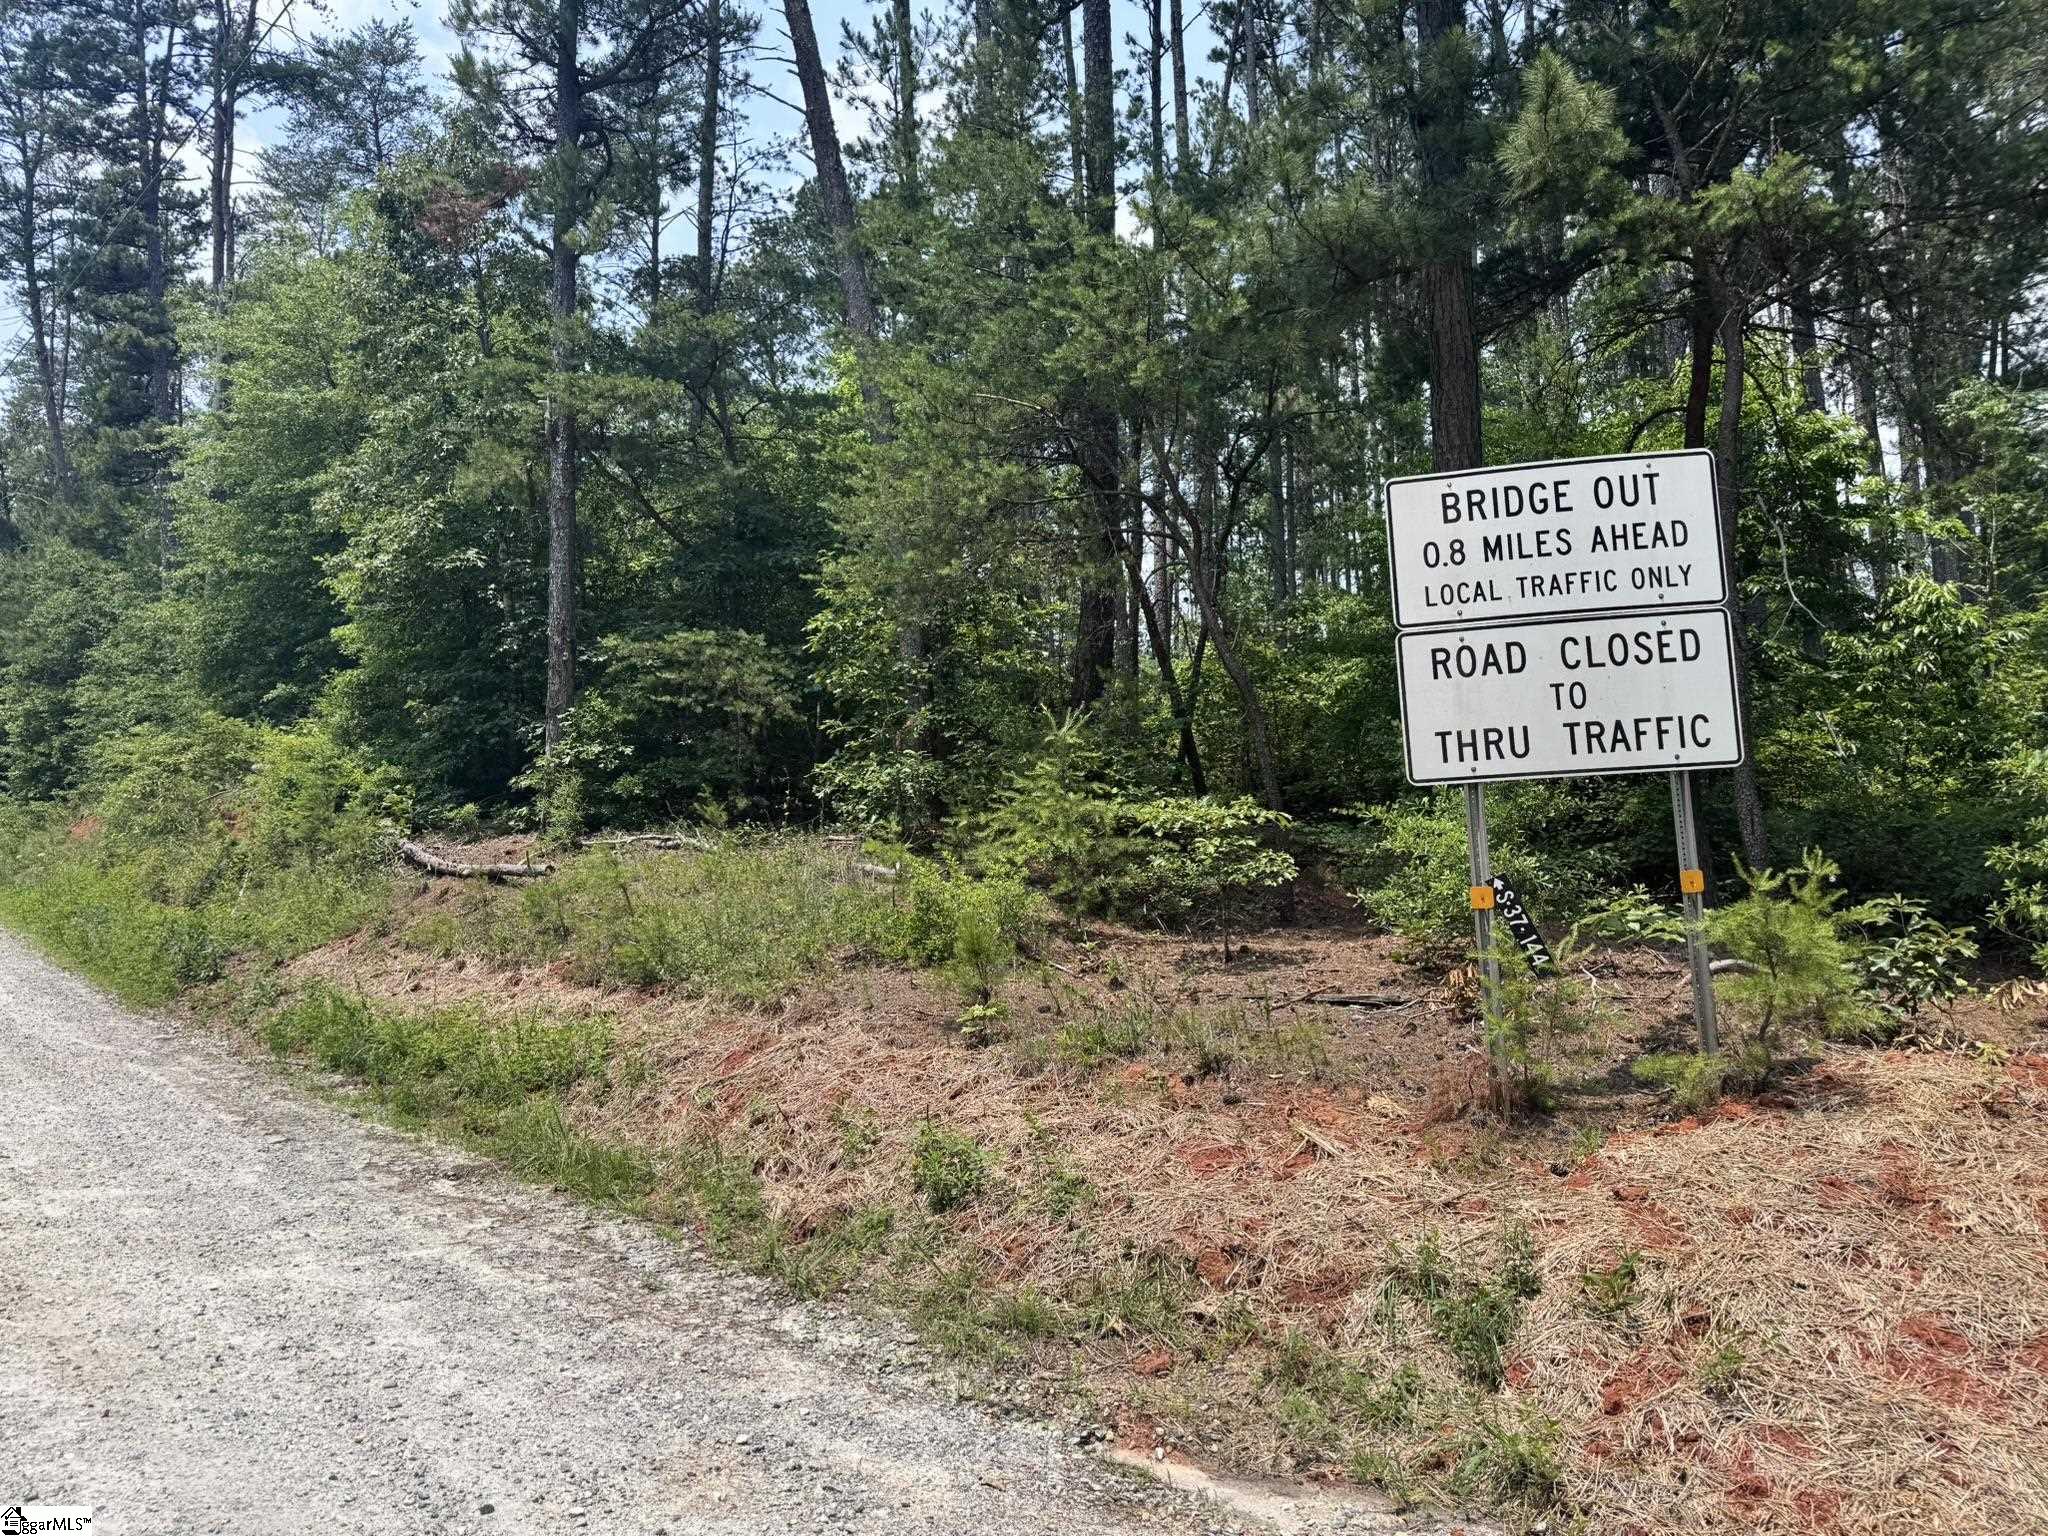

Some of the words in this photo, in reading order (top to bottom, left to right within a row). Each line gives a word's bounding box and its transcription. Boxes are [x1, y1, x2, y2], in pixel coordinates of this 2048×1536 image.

[1440, 480, 1573, 524] BRIDGE
[1594, 472, 1660, 510] OUT
[1423, 538, 1466, 568] 0.8
[1482, 529, 1572, 563] MILES
[1591, 520, 1689, 553] AHEAD
[1425, 580, 1502, 607] LOCAL
[1516, 569, 1617, 599] TRAFFIC
[1631, 564, 1692, 590] ONLY
[1431, 641, 1527, 680] ROAD
[1560, 628, 1701, 670] CLOSED
[1550, 681, 1587, 711] TO
[1435, 725, 1531, 764] THRU
[1563, 713, 1711, 755] TRAFFIC
